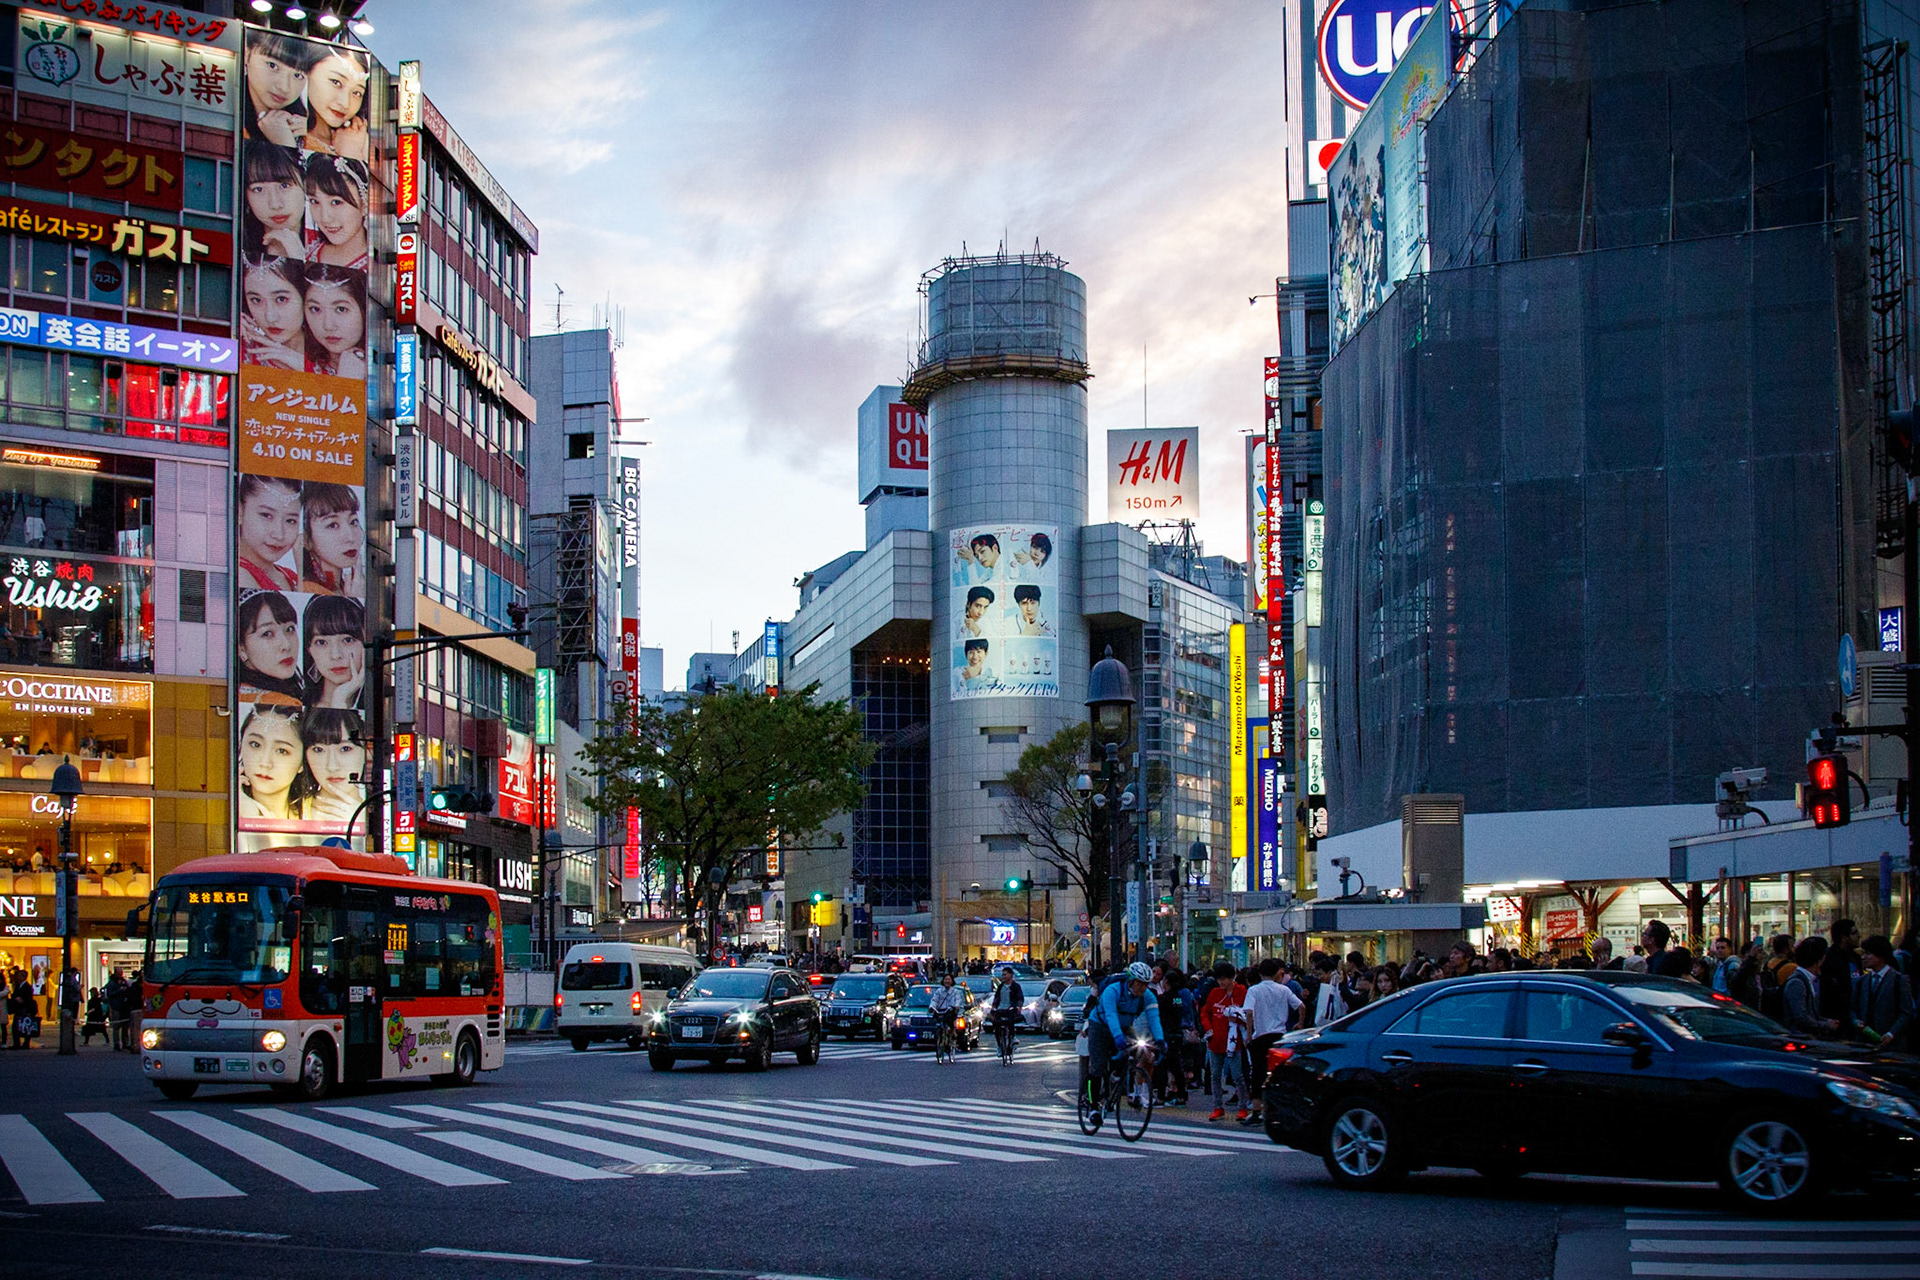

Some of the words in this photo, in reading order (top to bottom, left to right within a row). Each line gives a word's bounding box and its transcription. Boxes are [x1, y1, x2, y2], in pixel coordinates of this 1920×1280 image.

[22, 0, 227, 41] しゃぶバイキング
[94, 44, 227, 105] しゃぶ葉
[404, 80, 416, 124] しゃぶ葉
[4, 130, 176, 192] ンタクト
[403, 135, 413, 167] プライス
[402, 170, 413, 210] コンタクト
[405, 213, 416, 222] 8F
[112, 218, 209, 264] ガスト
[400, 271, 414, 315] ガスト
[46, 318, 232, 364] 英会話イーオン
[400, 343, 412, 416] 英会話イーオン
[247, 383, 359, 415] アンジュルム
[276, 412, 296, 423] NEW
[298, 415, 331, 427] SINGLE
[252, 442, 286, 459] 4.10
[290, 447, 312, 461] ON
[315, 451, 353, 466] SALE
[1118, 438, 1188, 486] H&M
[399, 443, 411, 519] 渋谷駅前ビル
[624, 466, 638, 495] BIC
[1126, 496, 1167, 509] 150m
[623, 497, 638, 569] CAMERA
[3, 577, 103, 612] Ushi8
[624, 631, 637, 658] 免税
[538, 671, 547, 699] レイク
[15, 702, 31, 711] EN
[34, 703, 93, 715] PROVENCE
[1235, 695, 1243, 756] Matsumoto
[1310, 699, 1319, 726] パーラー
[505, 770, 528, 796] アコム
[1311, 754, 1320, 783] フルーツ
[31, 795, 78, 818] Caé
[1234, 795, 1245, 807] 薬
[1264, 768, 1274, 812] MIZUHO
[498, 858, 532, 892] LUSH
[1263, 841, 1273, 888] みずほ銀行
[188, 891, 249, 904] 渋谷駅西口
